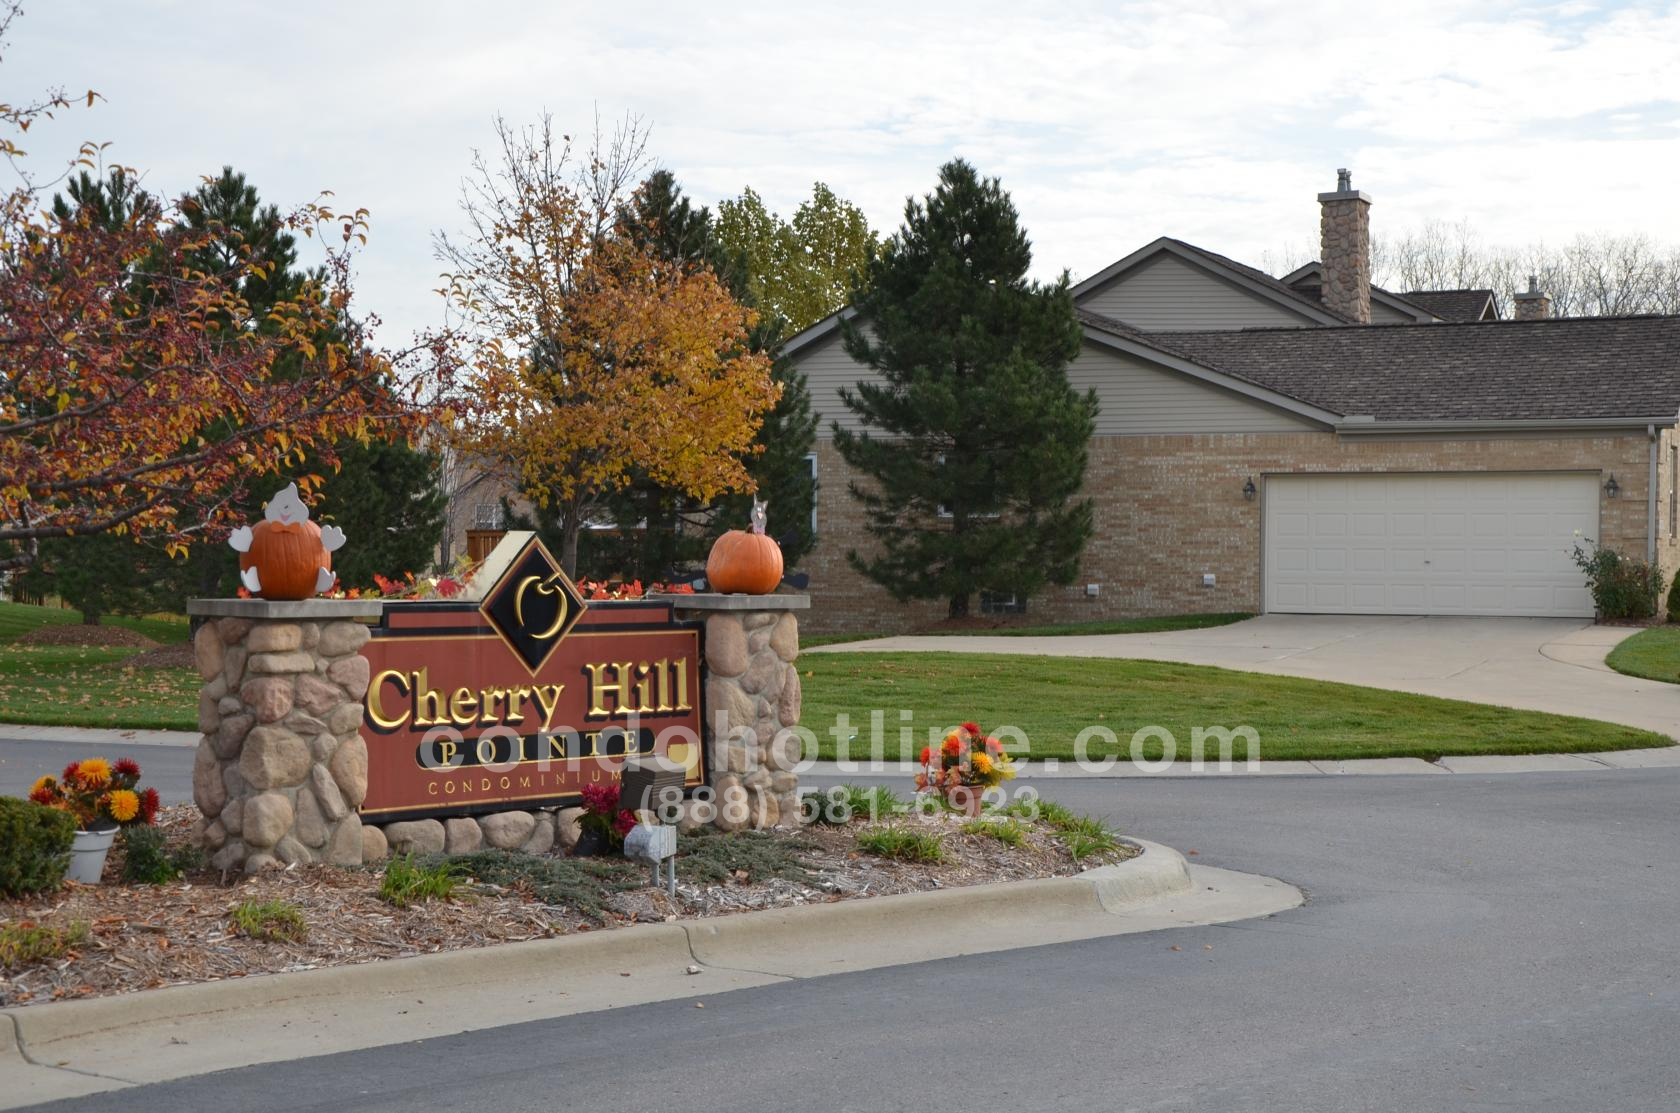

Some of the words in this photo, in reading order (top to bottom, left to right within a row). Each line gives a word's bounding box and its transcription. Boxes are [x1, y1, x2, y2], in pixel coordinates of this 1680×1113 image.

[366, 665, 565, 733] Cherry
[586, 656, 693, 717] Hill
[439, 730, 638, 767] POINTE
